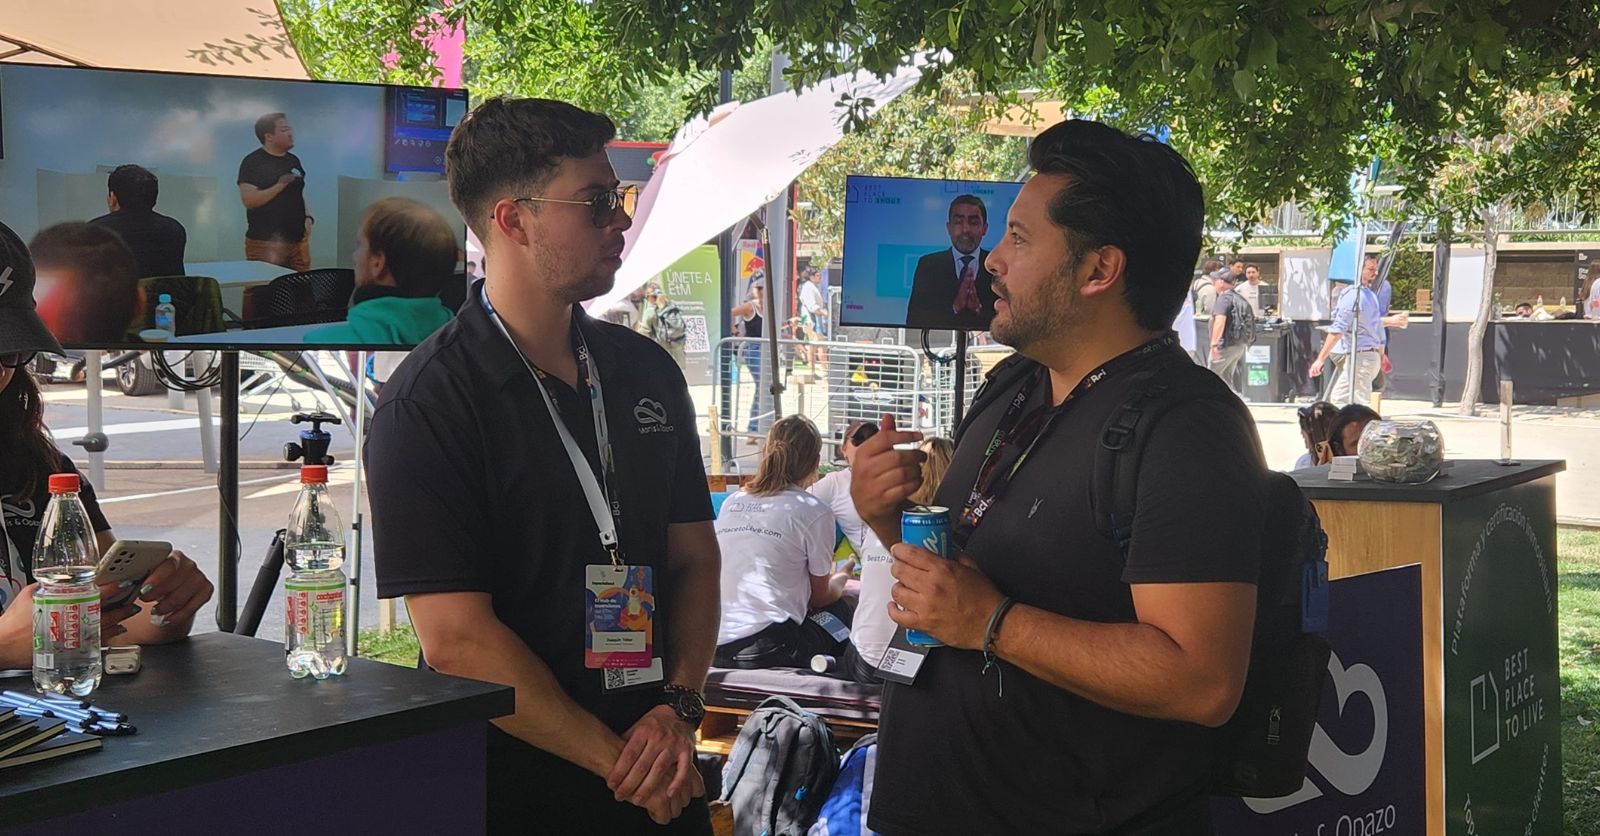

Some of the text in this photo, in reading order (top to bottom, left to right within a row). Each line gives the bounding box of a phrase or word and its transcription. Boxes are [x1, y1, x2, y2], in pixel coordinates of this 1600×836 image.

[704, 271, 713, 284] A
[1451, 541, 1482, 655] Plataforma
[1504, 647, 1528, 681] BEST
[1505, 674, 1534, 711] PLACE
[1505, 714, 1519, 741] TO
